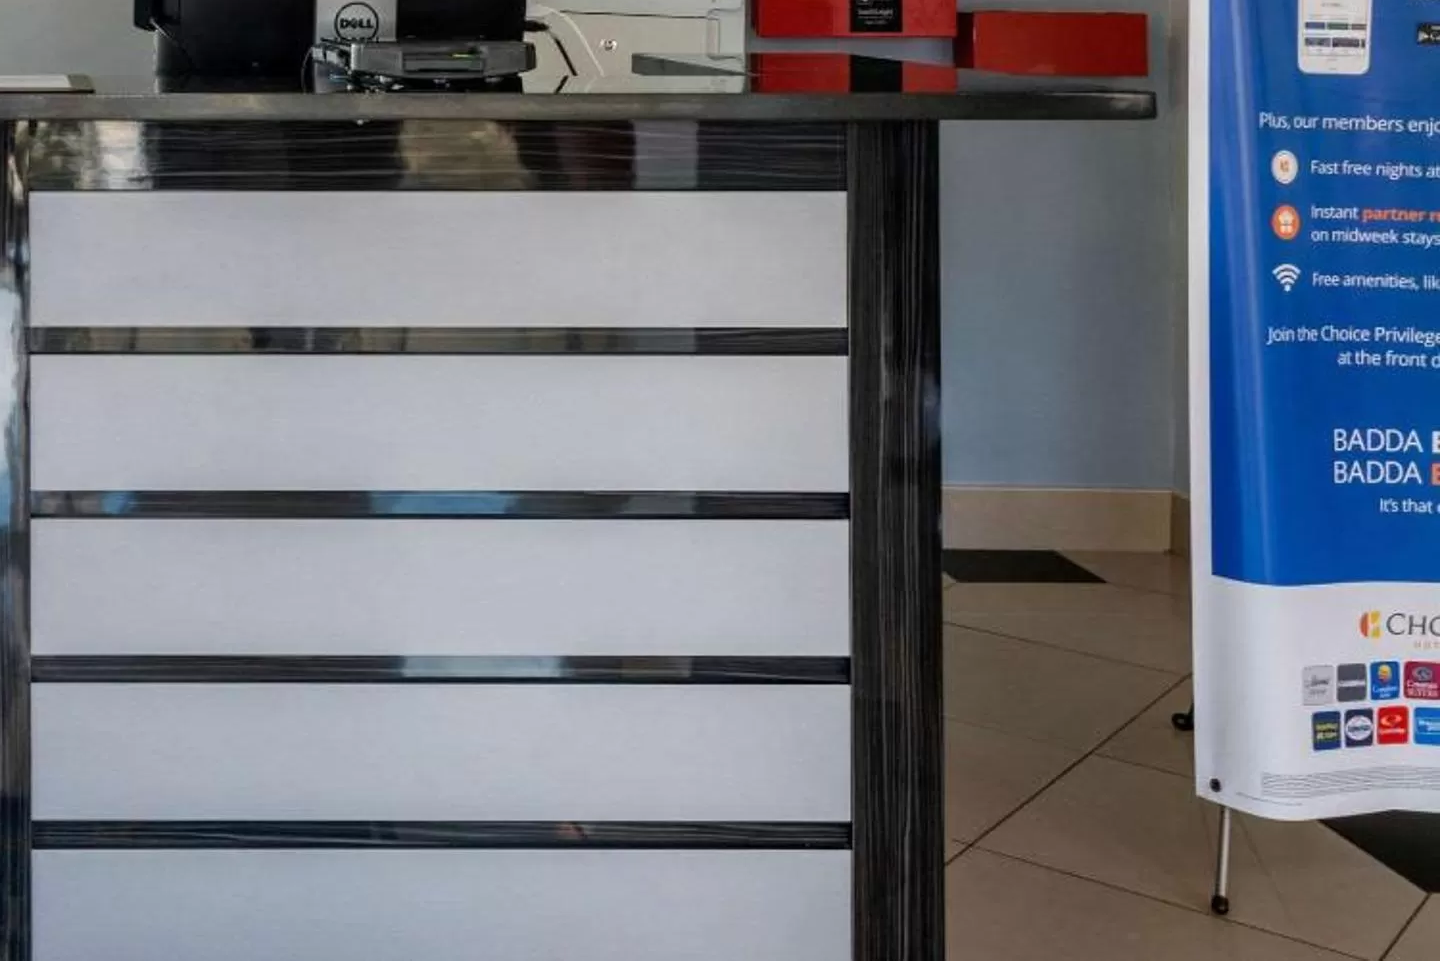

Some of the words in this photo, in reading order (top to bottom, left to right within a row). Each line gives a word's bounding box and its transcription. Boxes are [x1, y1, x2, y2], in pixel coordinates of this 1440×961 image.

[339, 18, 374, 29] DELL
[1259, 111, 1291, 130] Plus,
[1293, 116, 1317, 129] our
[1322, 114, 1405, 133] members
[1310, 159, 1339, 175] Fast
[1342, 159, 1372, 176] free
[1376, 162, 1423, 181] nights
[1310, 204, 1360, 219] Instant
[1362, 208, 1424, 223] partner
[1310, 230, 1330, 242] on
[1331, 227, 1399, 244] midweek
[1402, 231, 1440, 250] stays
[1312, 272, 1340, 288] Free
[1342, 274, 1420, 291] amenities,
[1266, 326, 1295, 345] Join
[1297, 325, 1318, 342] the
[1320, 324, 1370, 342] Choice
[1336, 351, 1352, 366] at
[1354, 349, 1381, 366] the
[1385, 349, 1428, 368] front
[1333, 427, 1424, 453] BADDA
[1333, 459, 1423, 485] BADDA
[1379, 497, 1399, 513] It's
[1402, 497, 1433, 515] that
